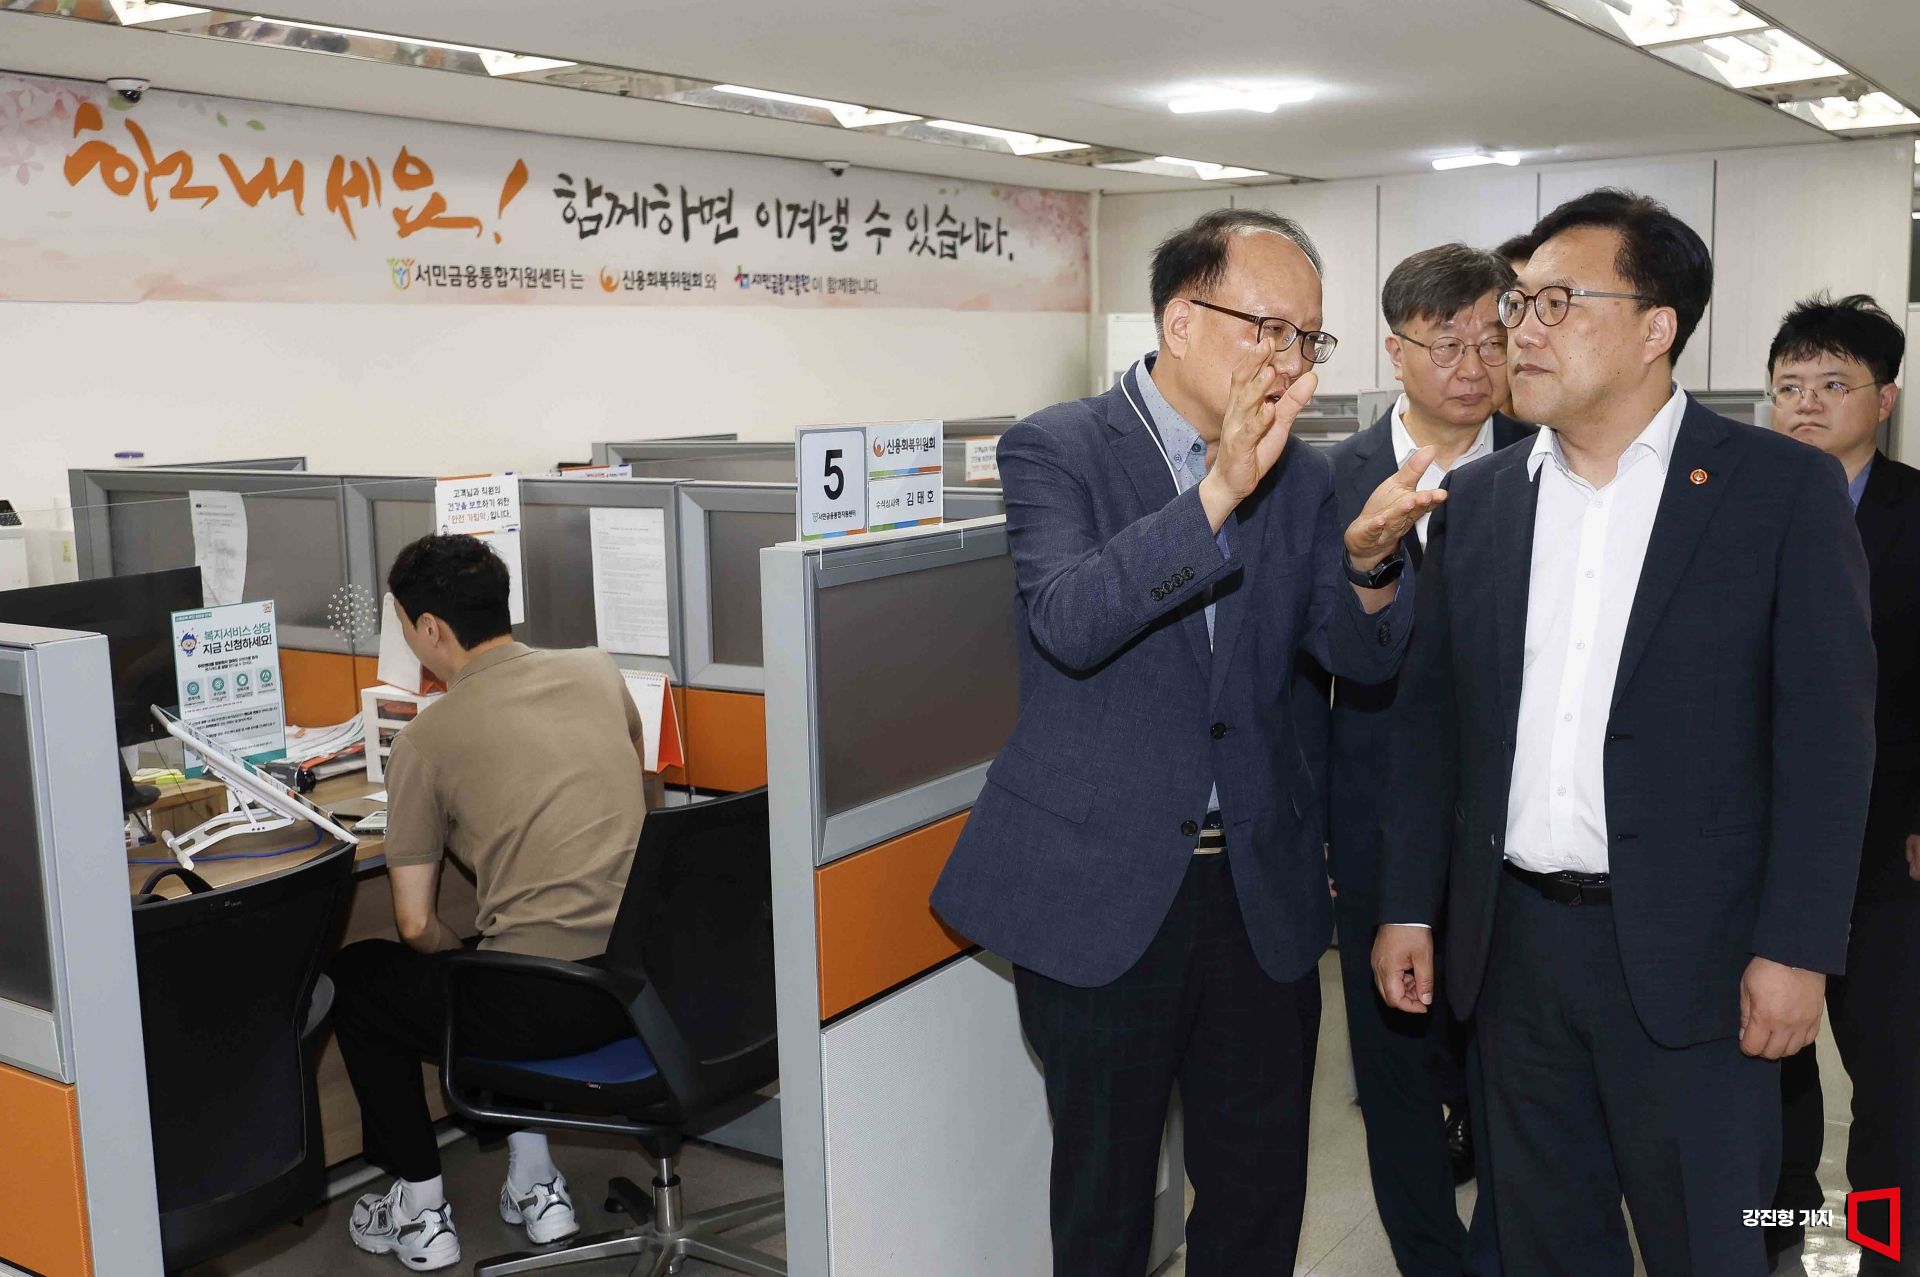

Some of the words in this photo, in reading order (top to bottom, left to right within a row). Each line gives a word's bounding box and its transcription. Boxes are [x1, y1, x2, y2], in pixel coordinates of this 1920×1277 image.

[553, 173, 739, 244] 함께하면
[756, 196, 850, 252] 이겨낼
[864, 200, 892, 255] 수
[905, 204, 1015, 262] 있습니다.
[887, 436, 936, 455] 신용회복위원회
[823, 449, 845, 500] 5
[453, 488, 480, 498] 고객님과
[481, 486, 501, 495] 직원의
[469, 499, 495, 509] 보호하기
[496, 497, 510, 507] 위한
[204, 625, 252, 642] 복지서비스
[252, 621, 271, 634] 상담
[202, 642, 222, 655] 지금
[224, 634, 273, 652] 신청하세요!
